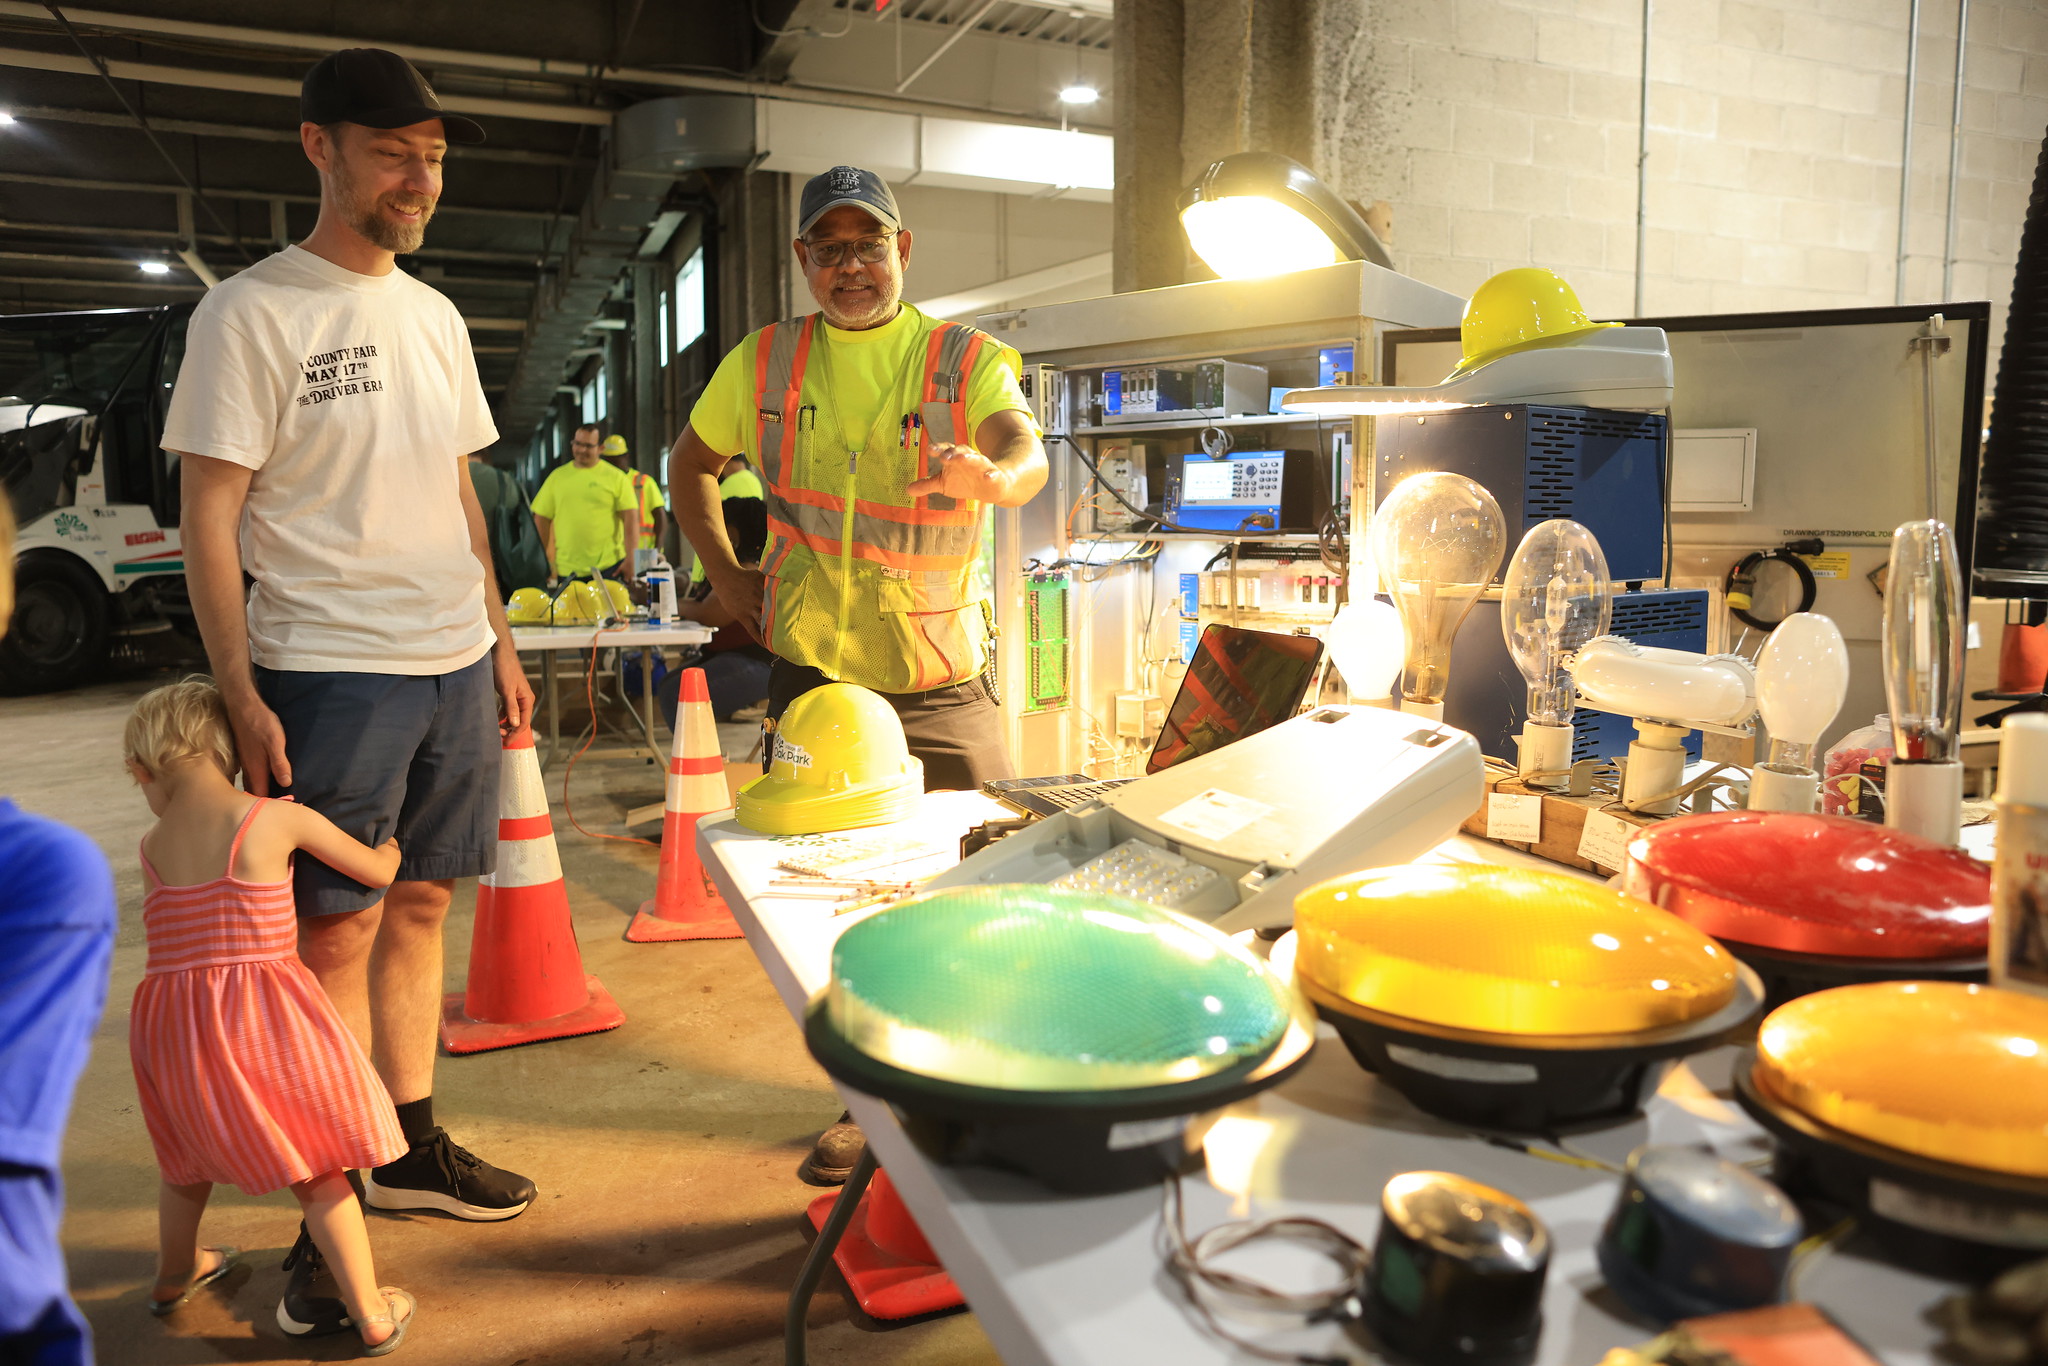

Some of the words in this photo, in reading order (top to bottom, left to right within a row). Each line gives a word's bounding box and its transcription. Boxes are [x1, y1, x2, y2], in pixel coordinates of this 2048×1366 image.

[830, 179, 860, 187] STUFF
[838, 171, 860, 181] FIX
[306, 348, 350, 368] COUNTY
[353, 345, 378, 359] FAIR
[305, 366, 338, 384] MAY
[343, 361, 369, 376] 17TH
[309, 383, 359, 404] DRIVER
[362, 380, 383, 394] ERA
[786, 751, 810, 766] Park
